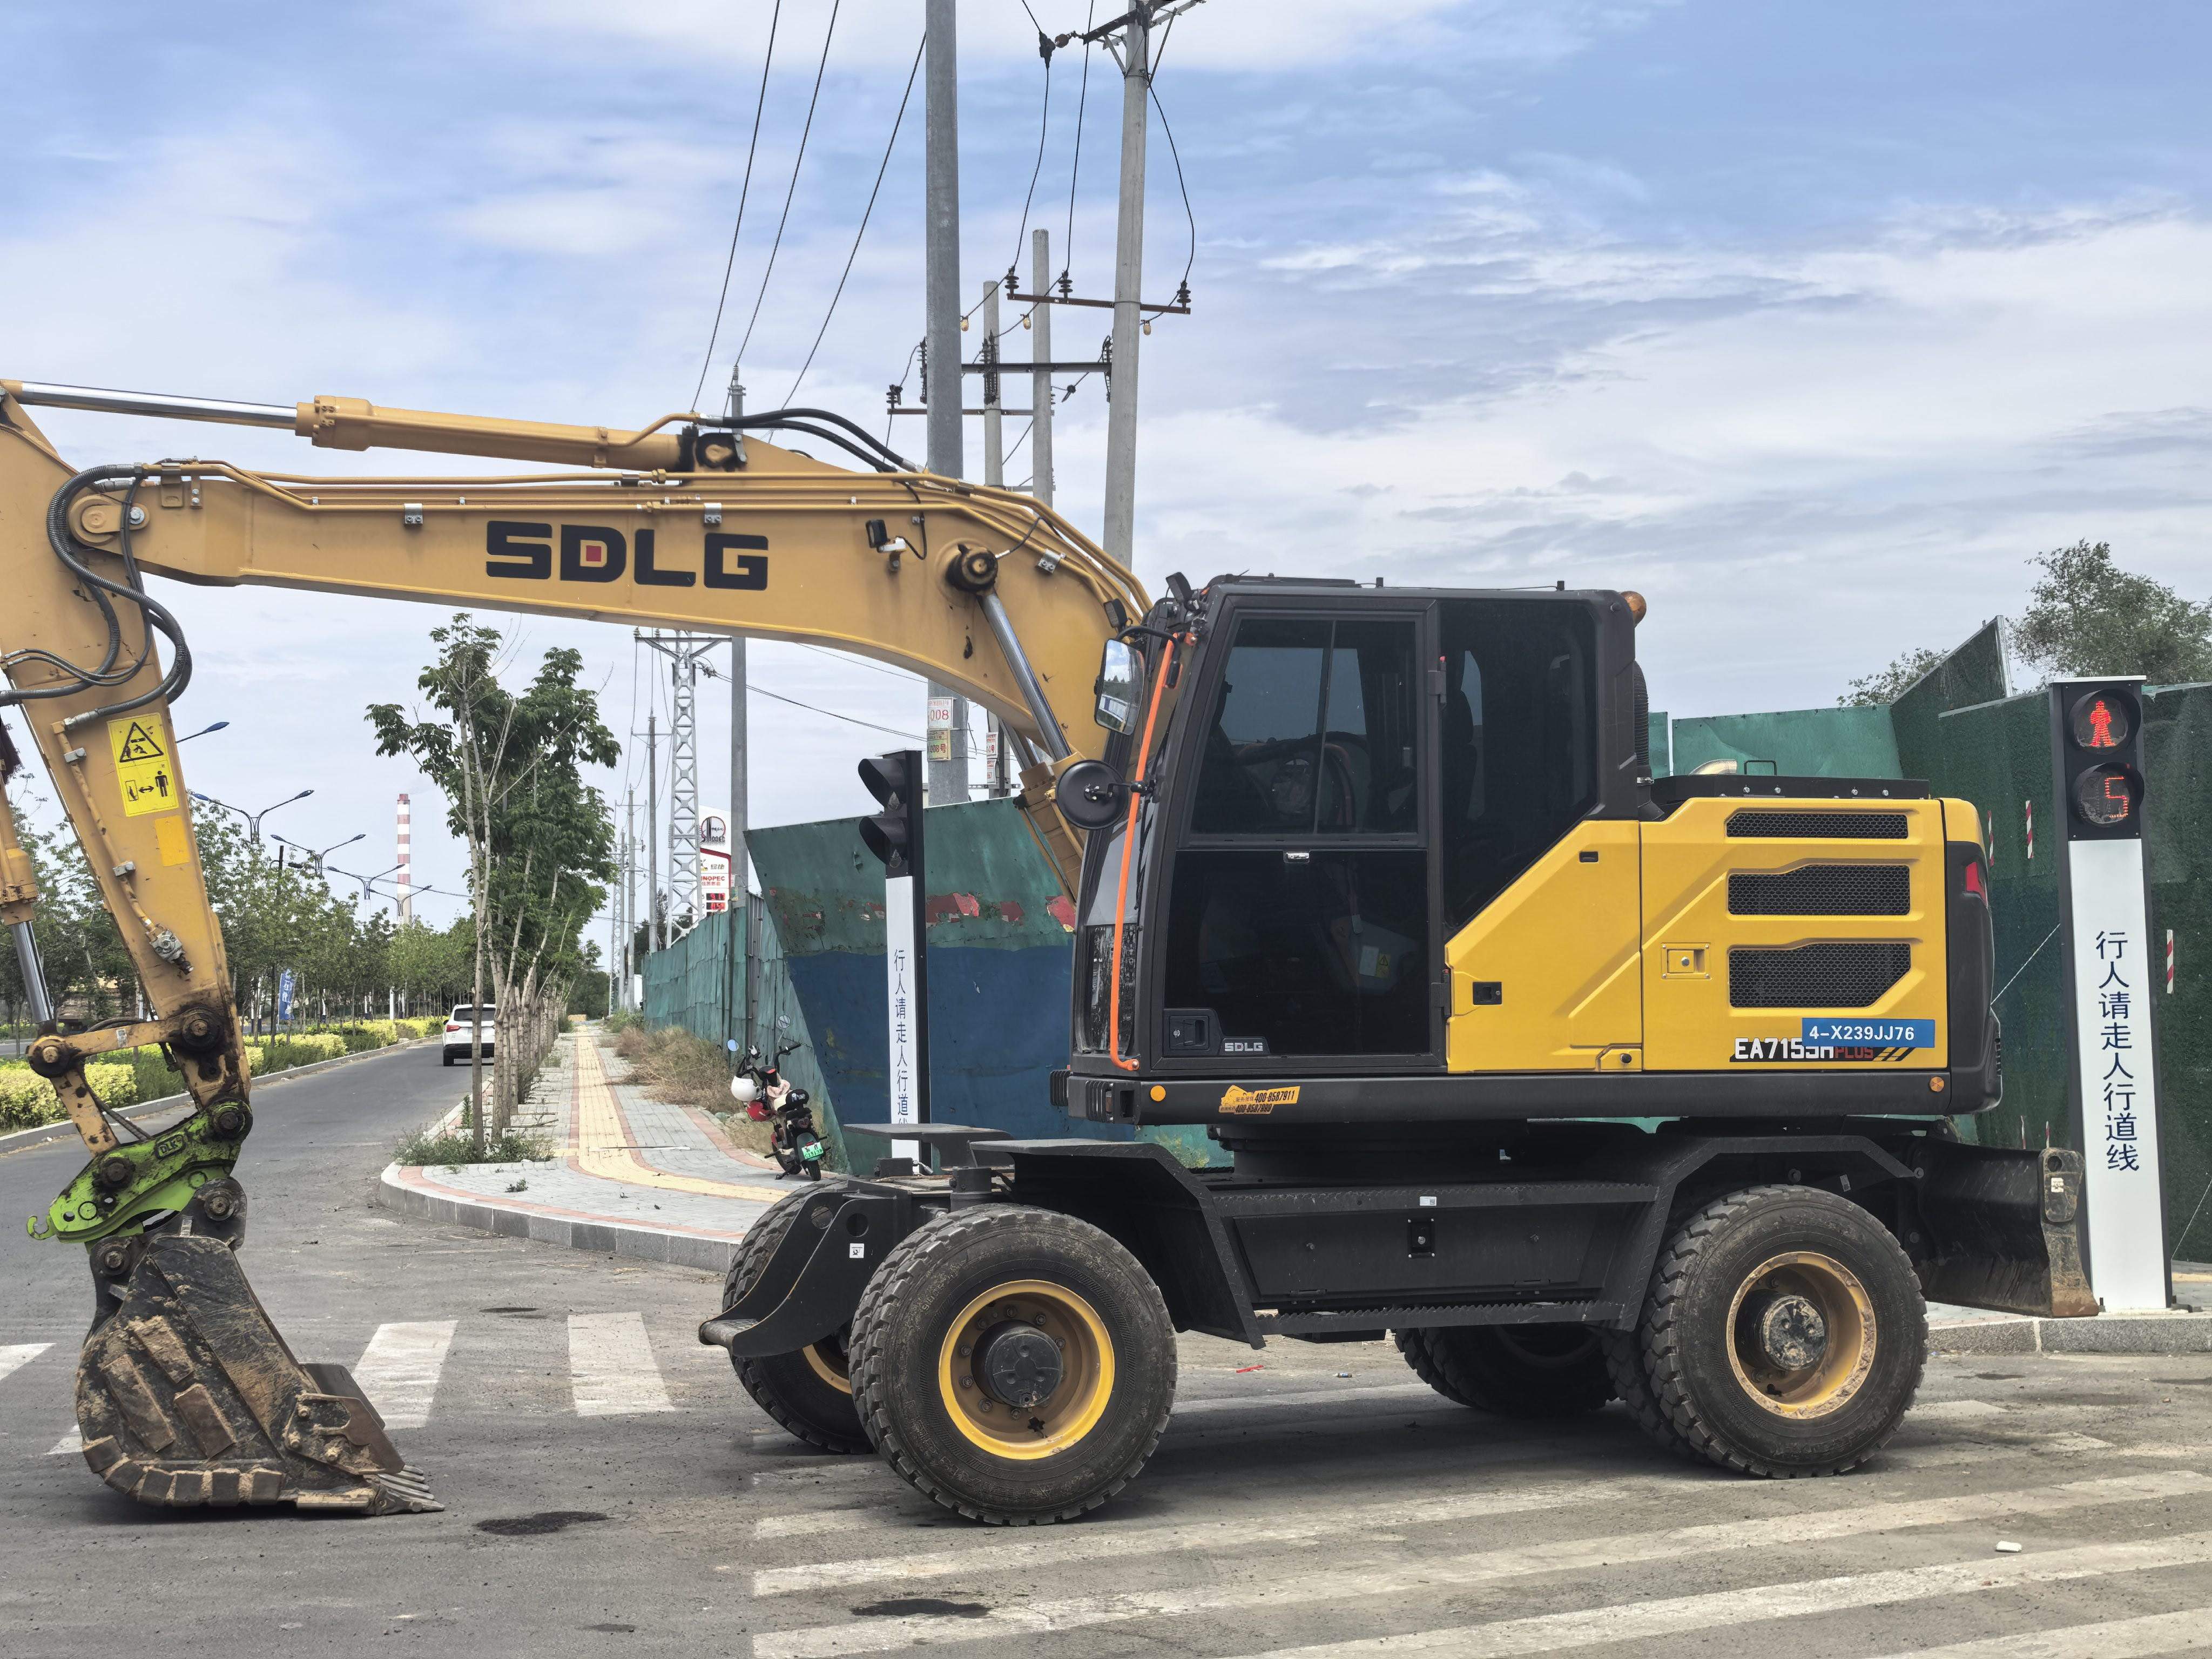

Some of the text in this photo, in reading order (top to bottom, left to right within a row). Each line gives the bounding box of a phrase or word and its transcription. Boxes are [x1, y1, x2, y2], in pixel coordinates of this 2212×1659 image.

[486, 520, 768, 590] SDLG
[894, 949, 908, 1124] 行人请走人行道
[1224, 1042, 1264, 1051] SDLG
[1809, 1026, 1914, 1041] 4-X239JJ76
[2096, 930, 2140, 1171] 行人请走人行道线
